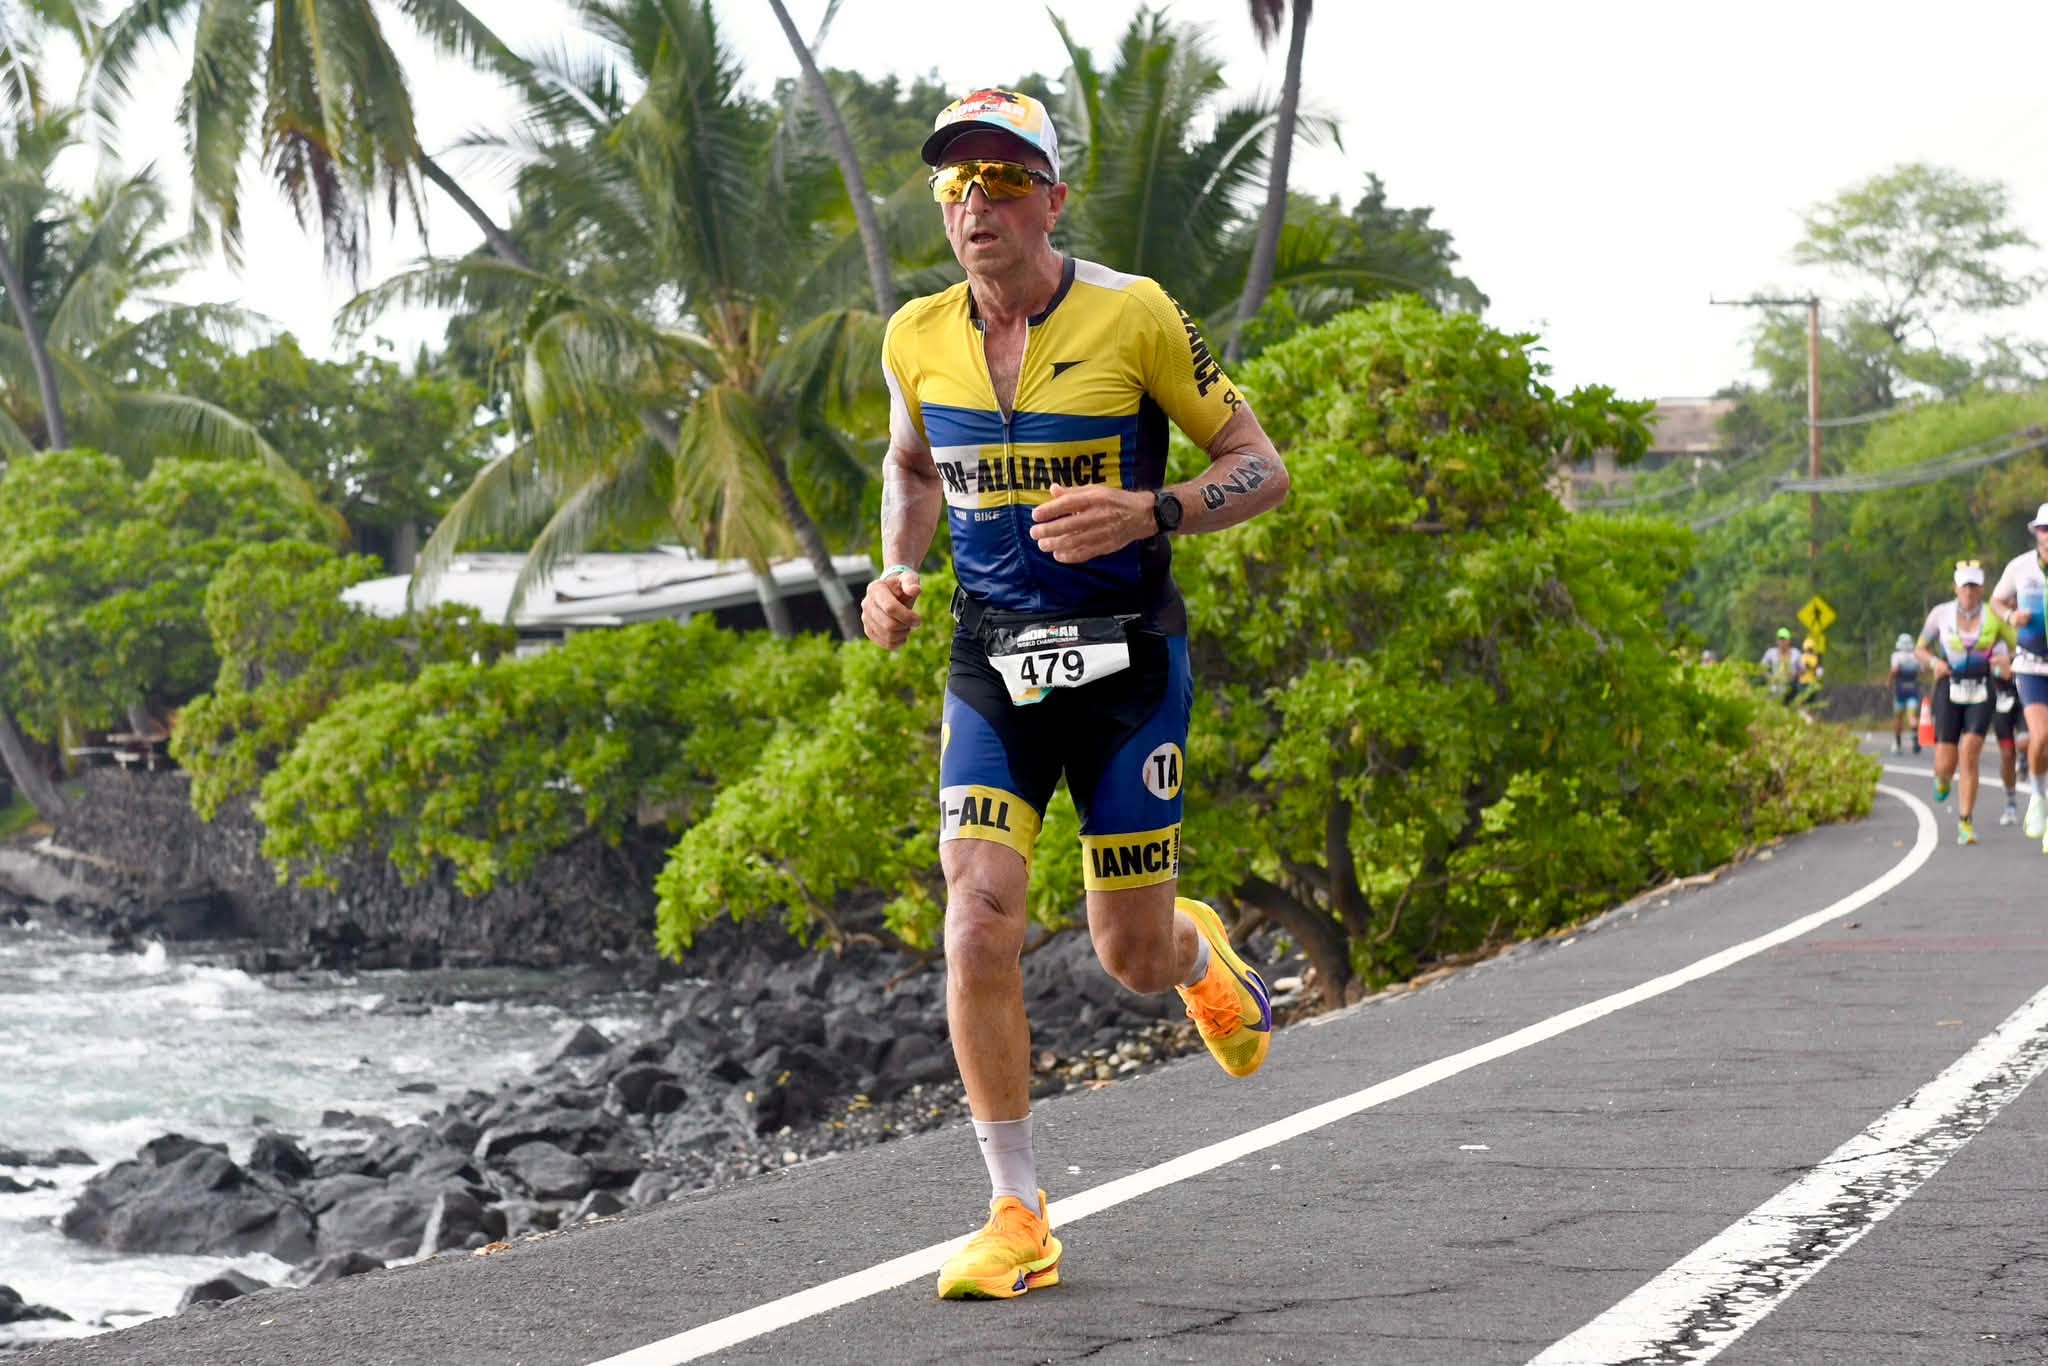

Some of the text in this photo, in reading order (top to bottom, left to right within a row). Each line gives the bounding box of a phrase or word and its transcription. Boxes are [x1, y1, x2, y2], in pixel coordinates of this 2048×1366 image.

[974, 510, 1001, 522] BIKE
[1020, 650, 1085, 686] 479
[1153, 753, 1179, 789] TA
[1091, 838, 1170, 878] IANCE
